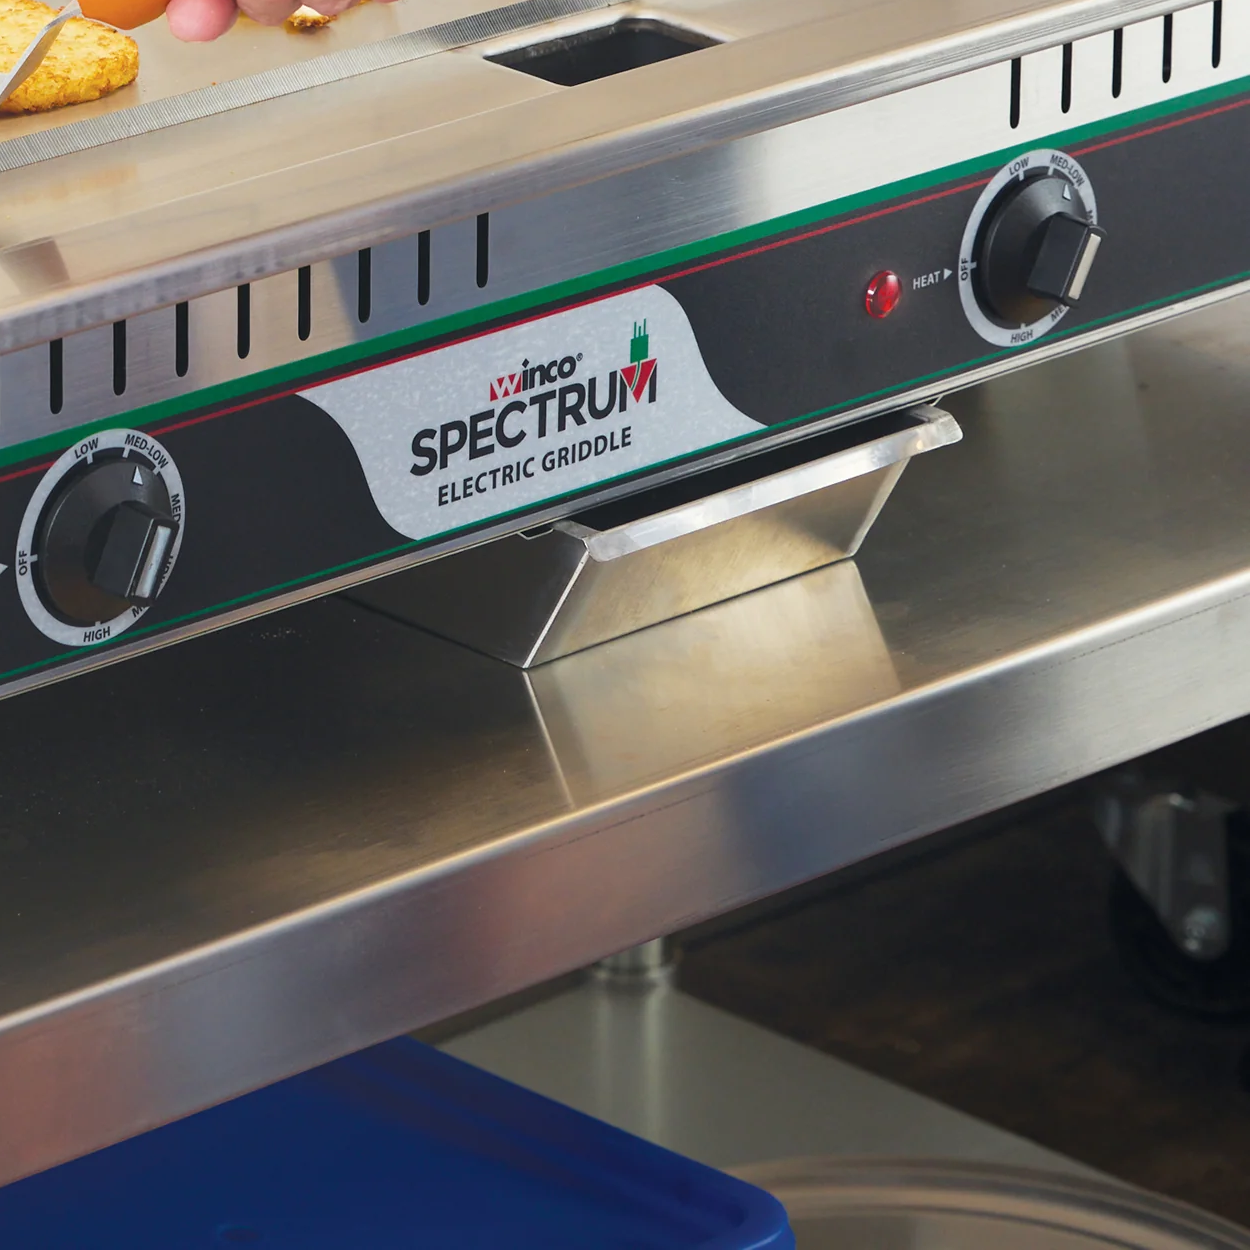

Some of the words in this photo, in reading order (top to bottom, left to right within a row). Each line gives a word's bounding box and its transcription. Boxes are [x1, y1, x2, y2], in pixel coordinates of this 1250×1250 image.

[1008, 156, 1030, 176] LOW
[1049, 153, 1086, 187] MED-LOW
[912, 270, 941, 290] HEAT
[960, 257, 969, 281] OFF
[1010, 329, 1034, 344] HIGH
[409, 358, 657, 477] SPECTRUM
[74, 437, 99, 459] LOW
[124, 433, 169, 469] MED-LOW
[437, 456, 535, 507] ELECTRIC
[541, 425, 632, 472] GRIDDLE
[18, 550, 28, 576] OFF
[83, 625, 111, 643] HIGH
